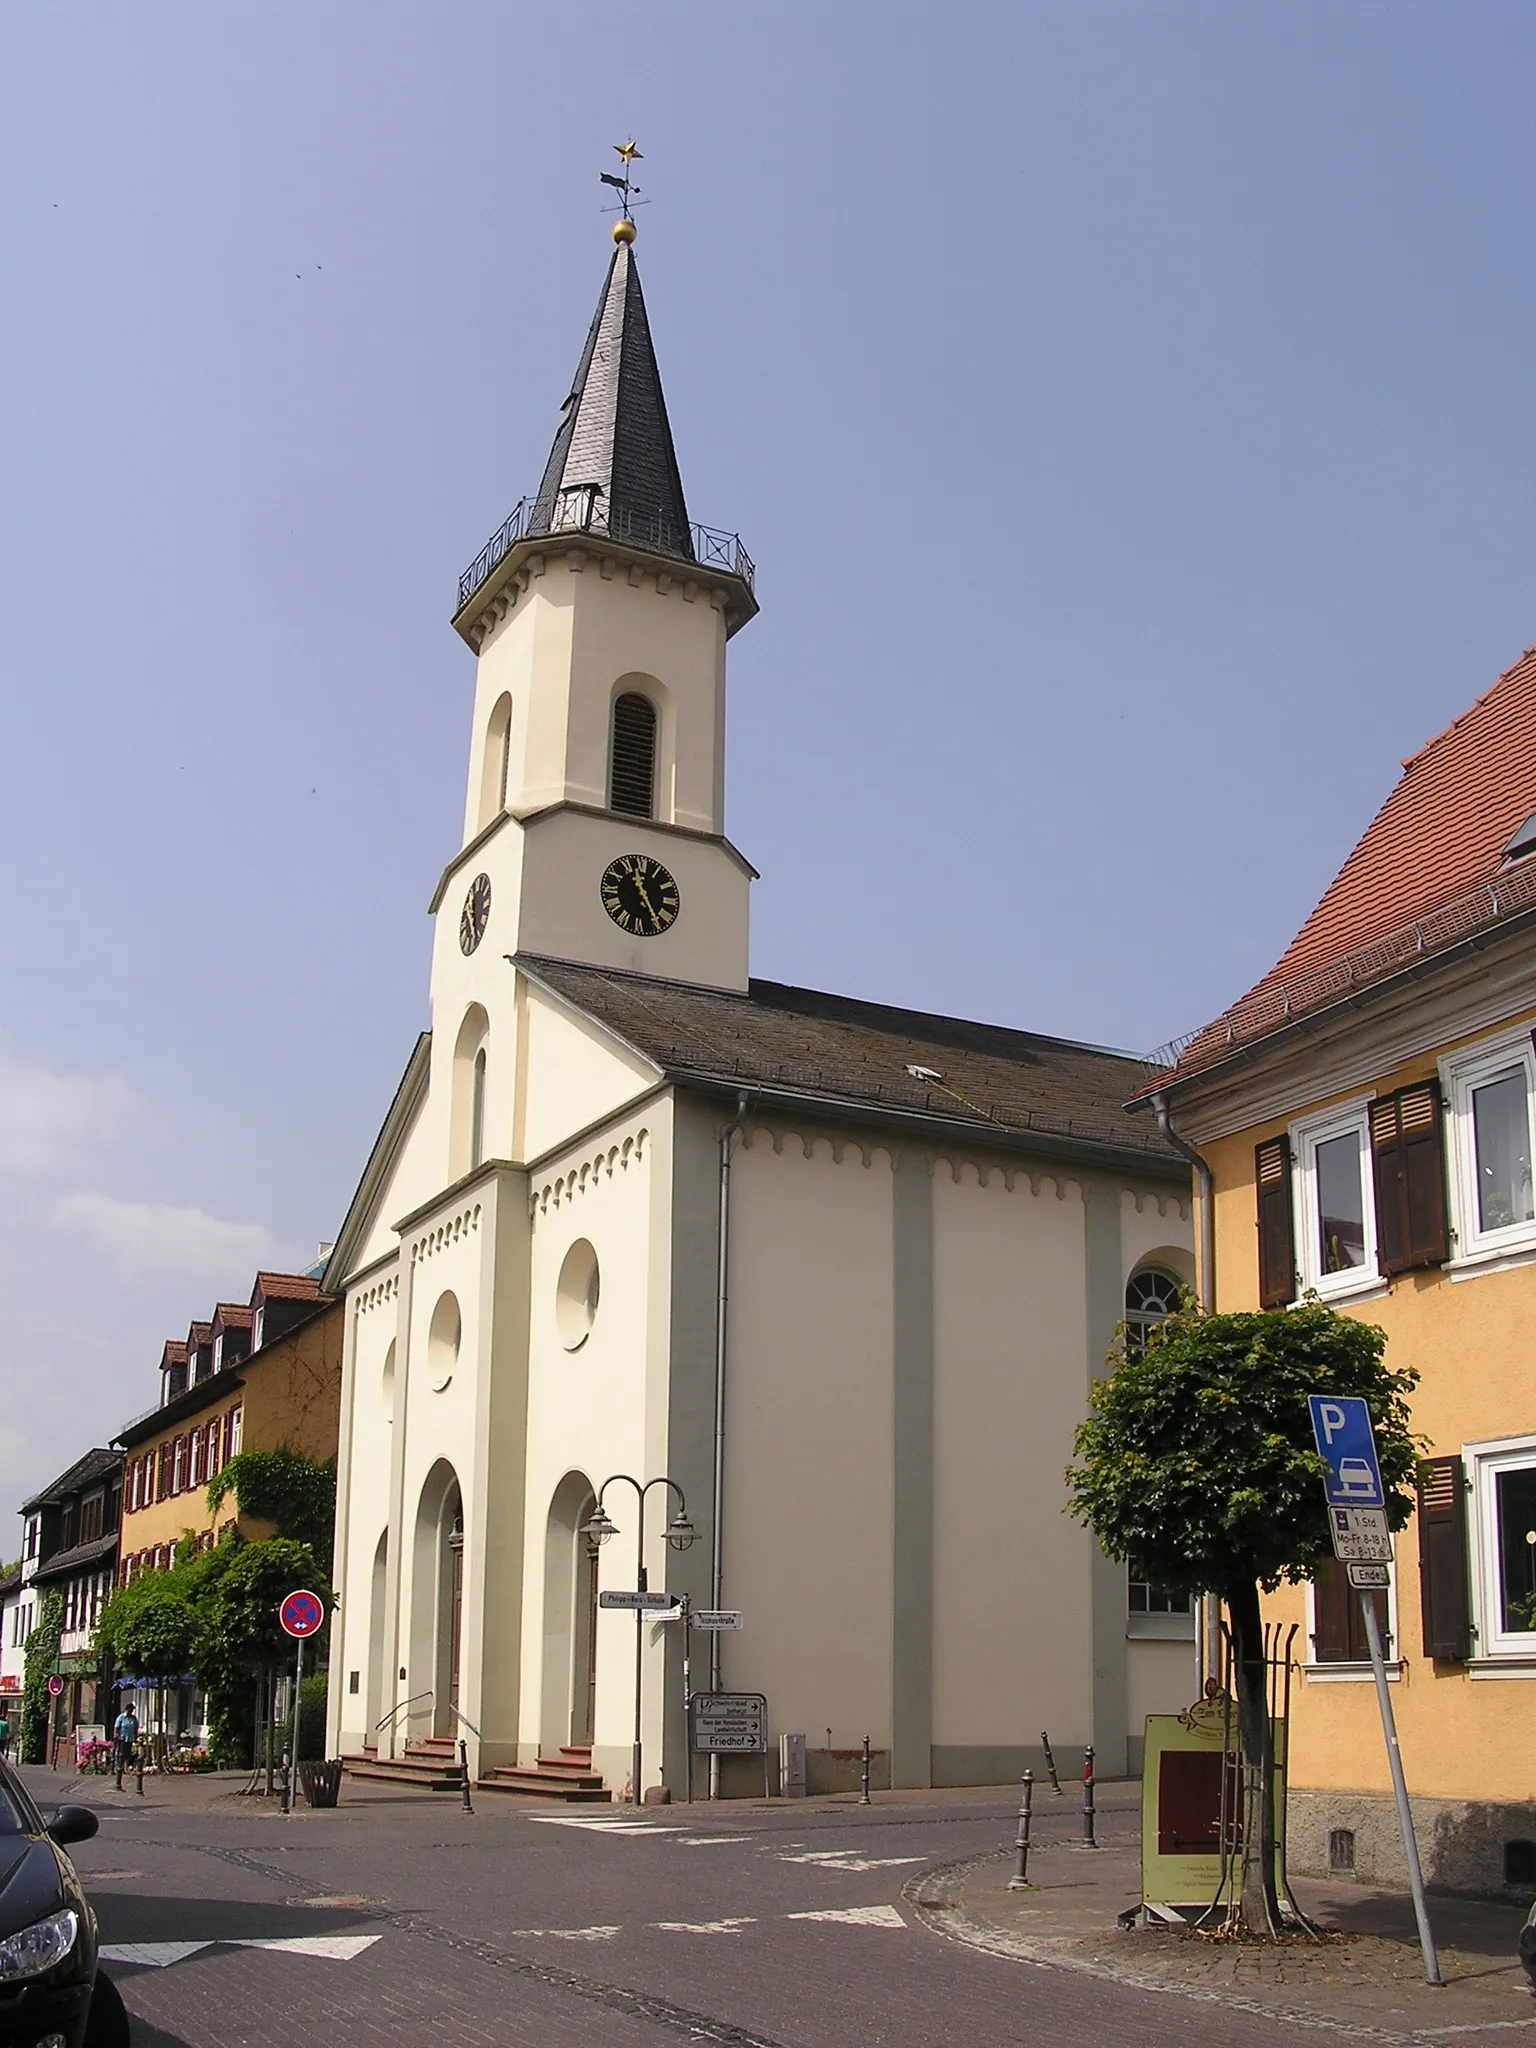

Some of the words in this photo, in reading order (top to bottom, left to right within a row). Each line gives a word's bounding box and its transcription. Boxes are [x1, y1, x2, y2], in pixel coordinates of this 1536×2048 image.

[1320, 1403, 1346, 1445] P
[1354, 1517, 1359, 1526] 1
[1336, 1533, 1361, 1544] Mo-Fr
[1363, 1535, 1380, 1545] 8-18
[1381, 1535, 1387, 1545] h
[1343, 1546, 1355, 1556] Sa
[1358, 1547, 1376, 1557] 8-13
[1358, 1570, 1380, 1580] Ende
[709, 1736, 745, 1746] Friedhof
